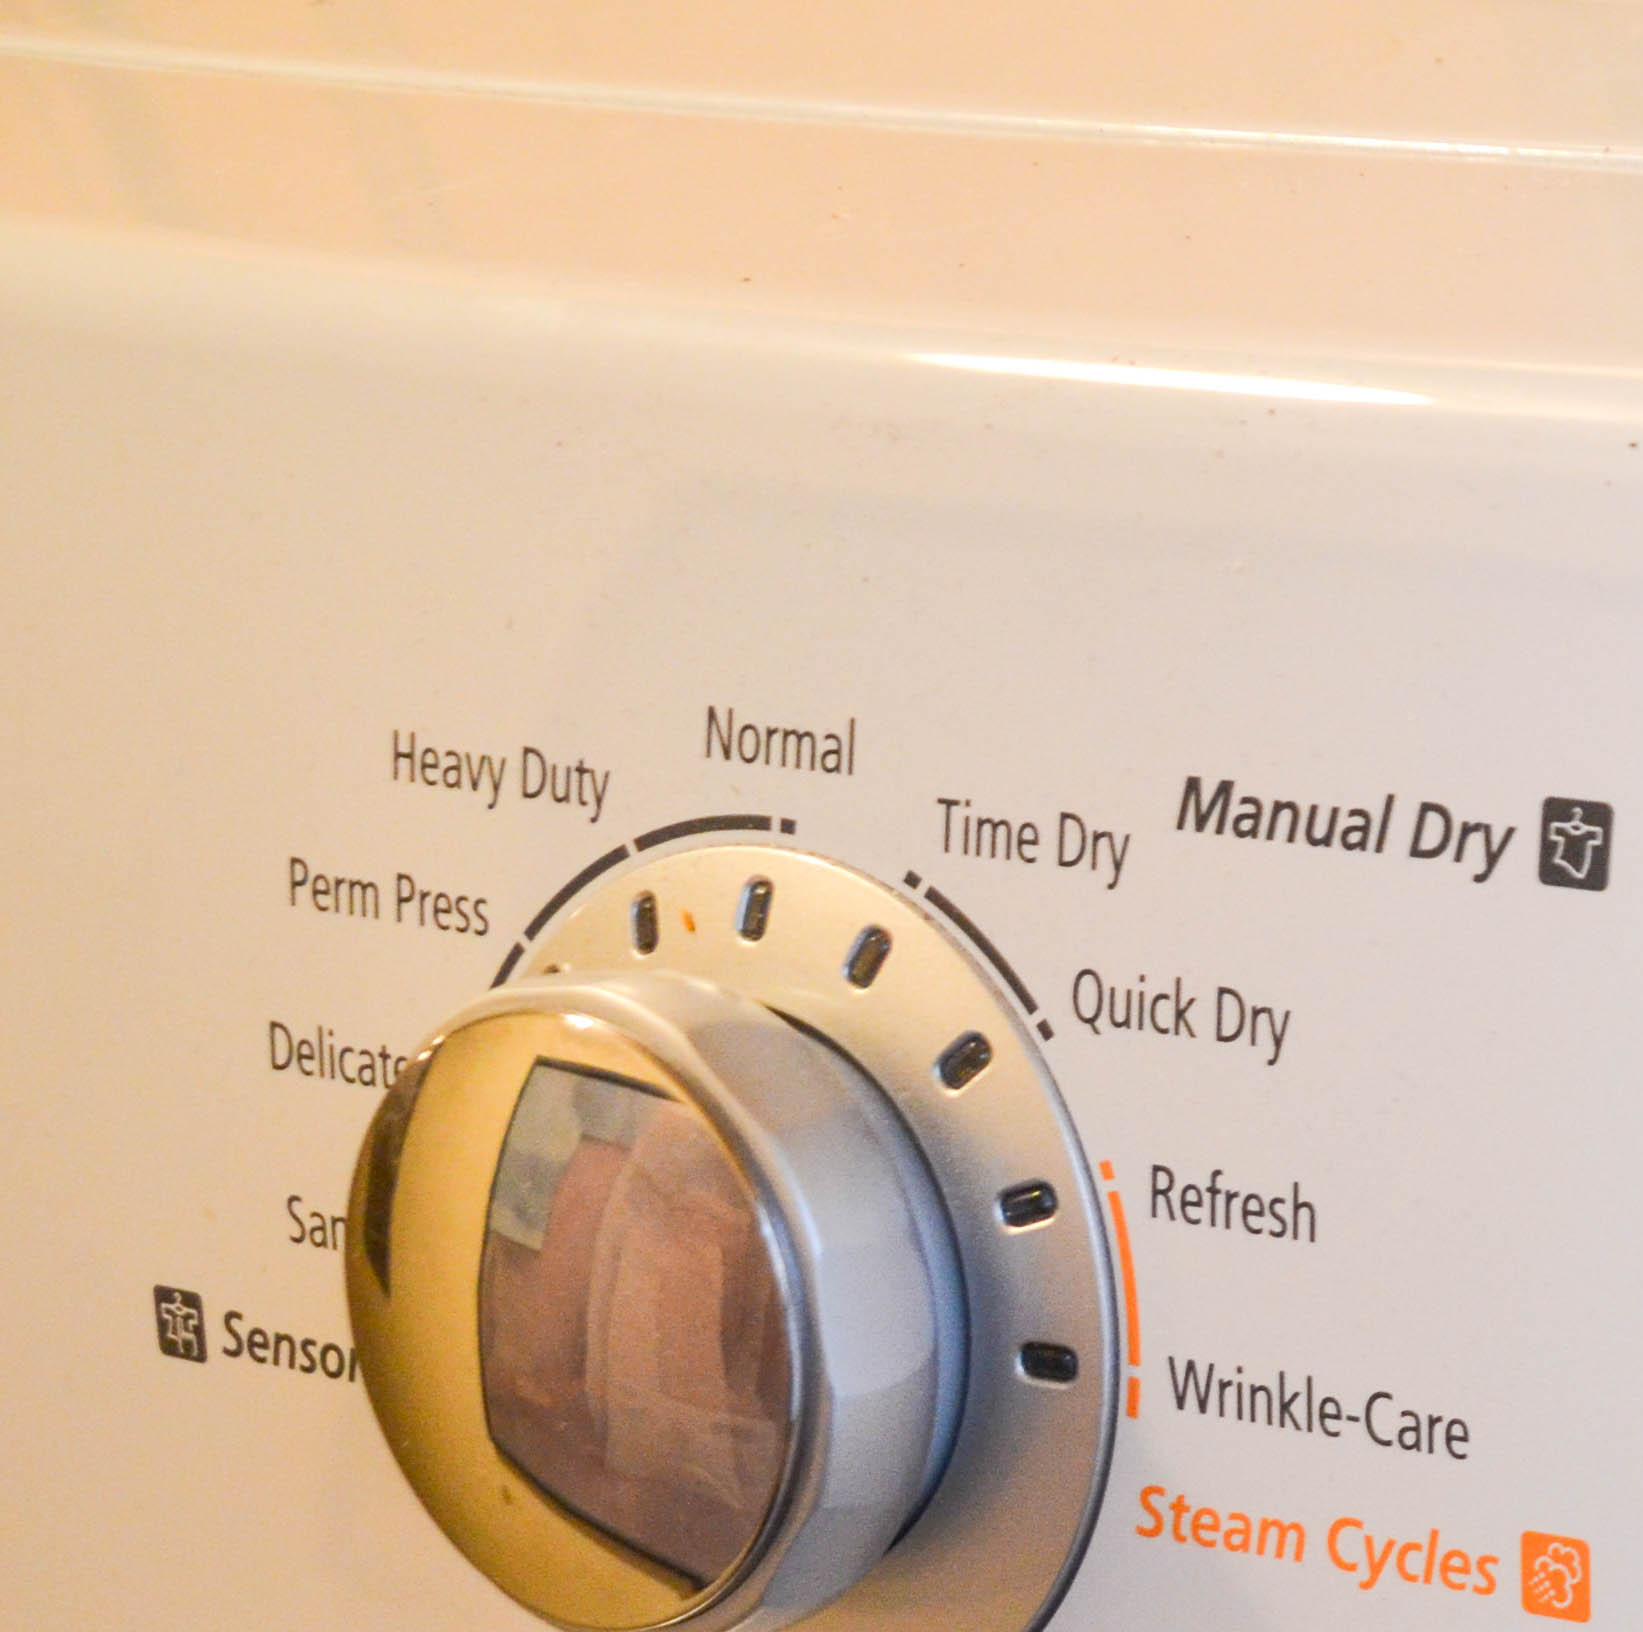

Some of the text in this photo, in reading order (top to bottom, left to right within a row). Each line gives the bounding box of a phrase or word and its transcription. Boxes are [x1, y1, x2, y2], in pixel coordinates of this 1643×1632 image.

[393, 730, 610, 824] Heavy Duty
[706, 705, 855, 775] Normal
[936, 797, 1130, 890] Time Dry
[1176, 776, 1516, 884] Manual Dry
[289, 856, 489, 937] Perm Press
[1072, 968, 1291, 1067] Quick Dry
[1151, 1164, 1316, 1243] Refresh
[1168, 1356, 1470, 1460] Wrinkle-Care
[1136, 1485, 1499, 1596] Steam Cycles
